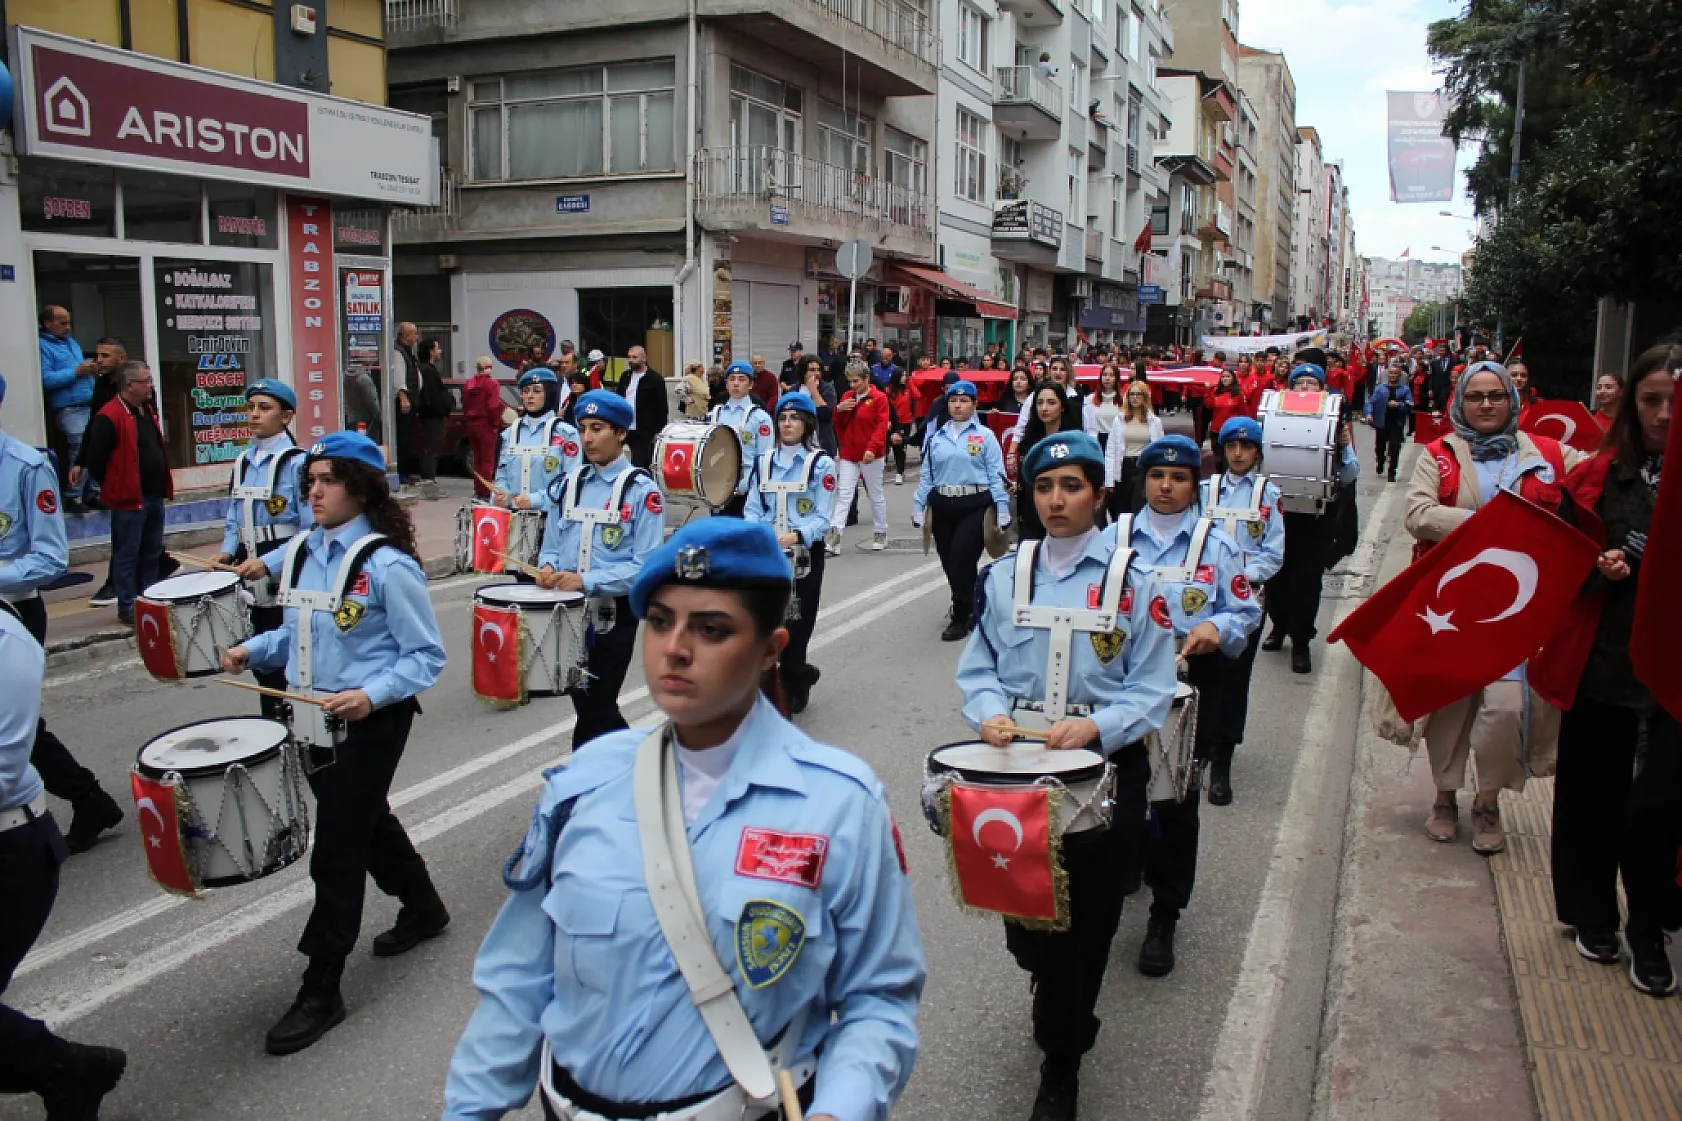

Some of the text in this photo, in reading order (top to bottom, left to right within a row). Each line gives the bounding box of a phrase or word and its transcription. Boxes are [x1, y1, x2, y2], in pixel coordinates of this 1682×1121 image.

[116, 105, 304, 164] ARISTON
[43, 195, 91, 219] ŞOFBEN
[173, 267, 233, 289] DOĞALGAZ
[300, 205, 323, 329] TRABZON
[347, 301, 380, 315] SATILIK
[195, 371, 245, 388] BOSCH
[204, 392, 248, 411] bayma
